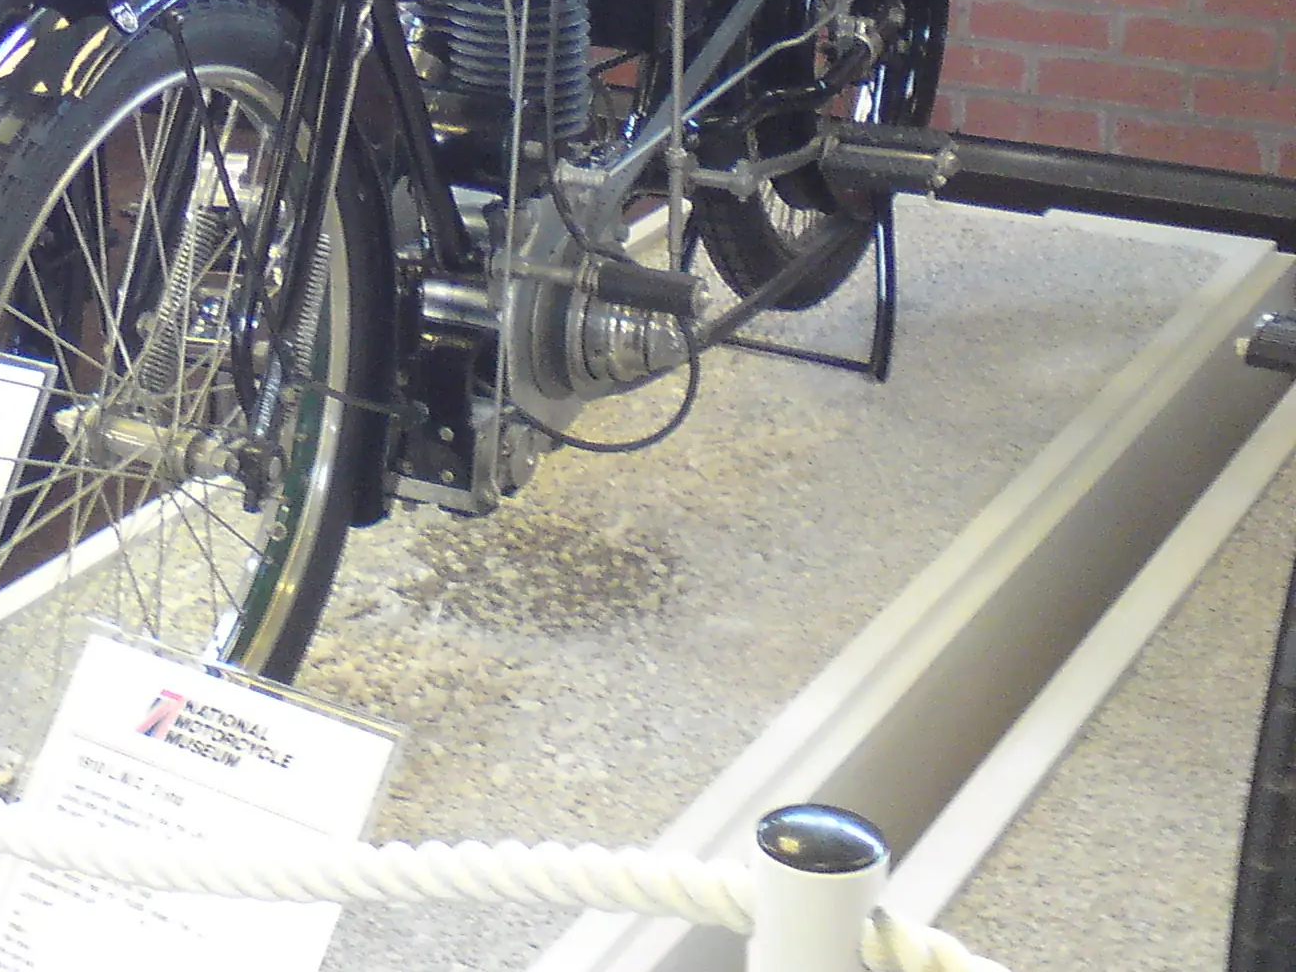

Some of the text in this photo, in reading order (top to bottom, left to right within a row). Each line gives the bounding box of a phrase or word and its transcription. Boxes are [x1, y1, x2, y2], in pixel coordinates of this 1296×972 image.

[173, 714, 295, 769] MOTORCYCLE
[184, 699, 269, 742] NATIONAL
[163, 730, 242, 768] MUSEUM
